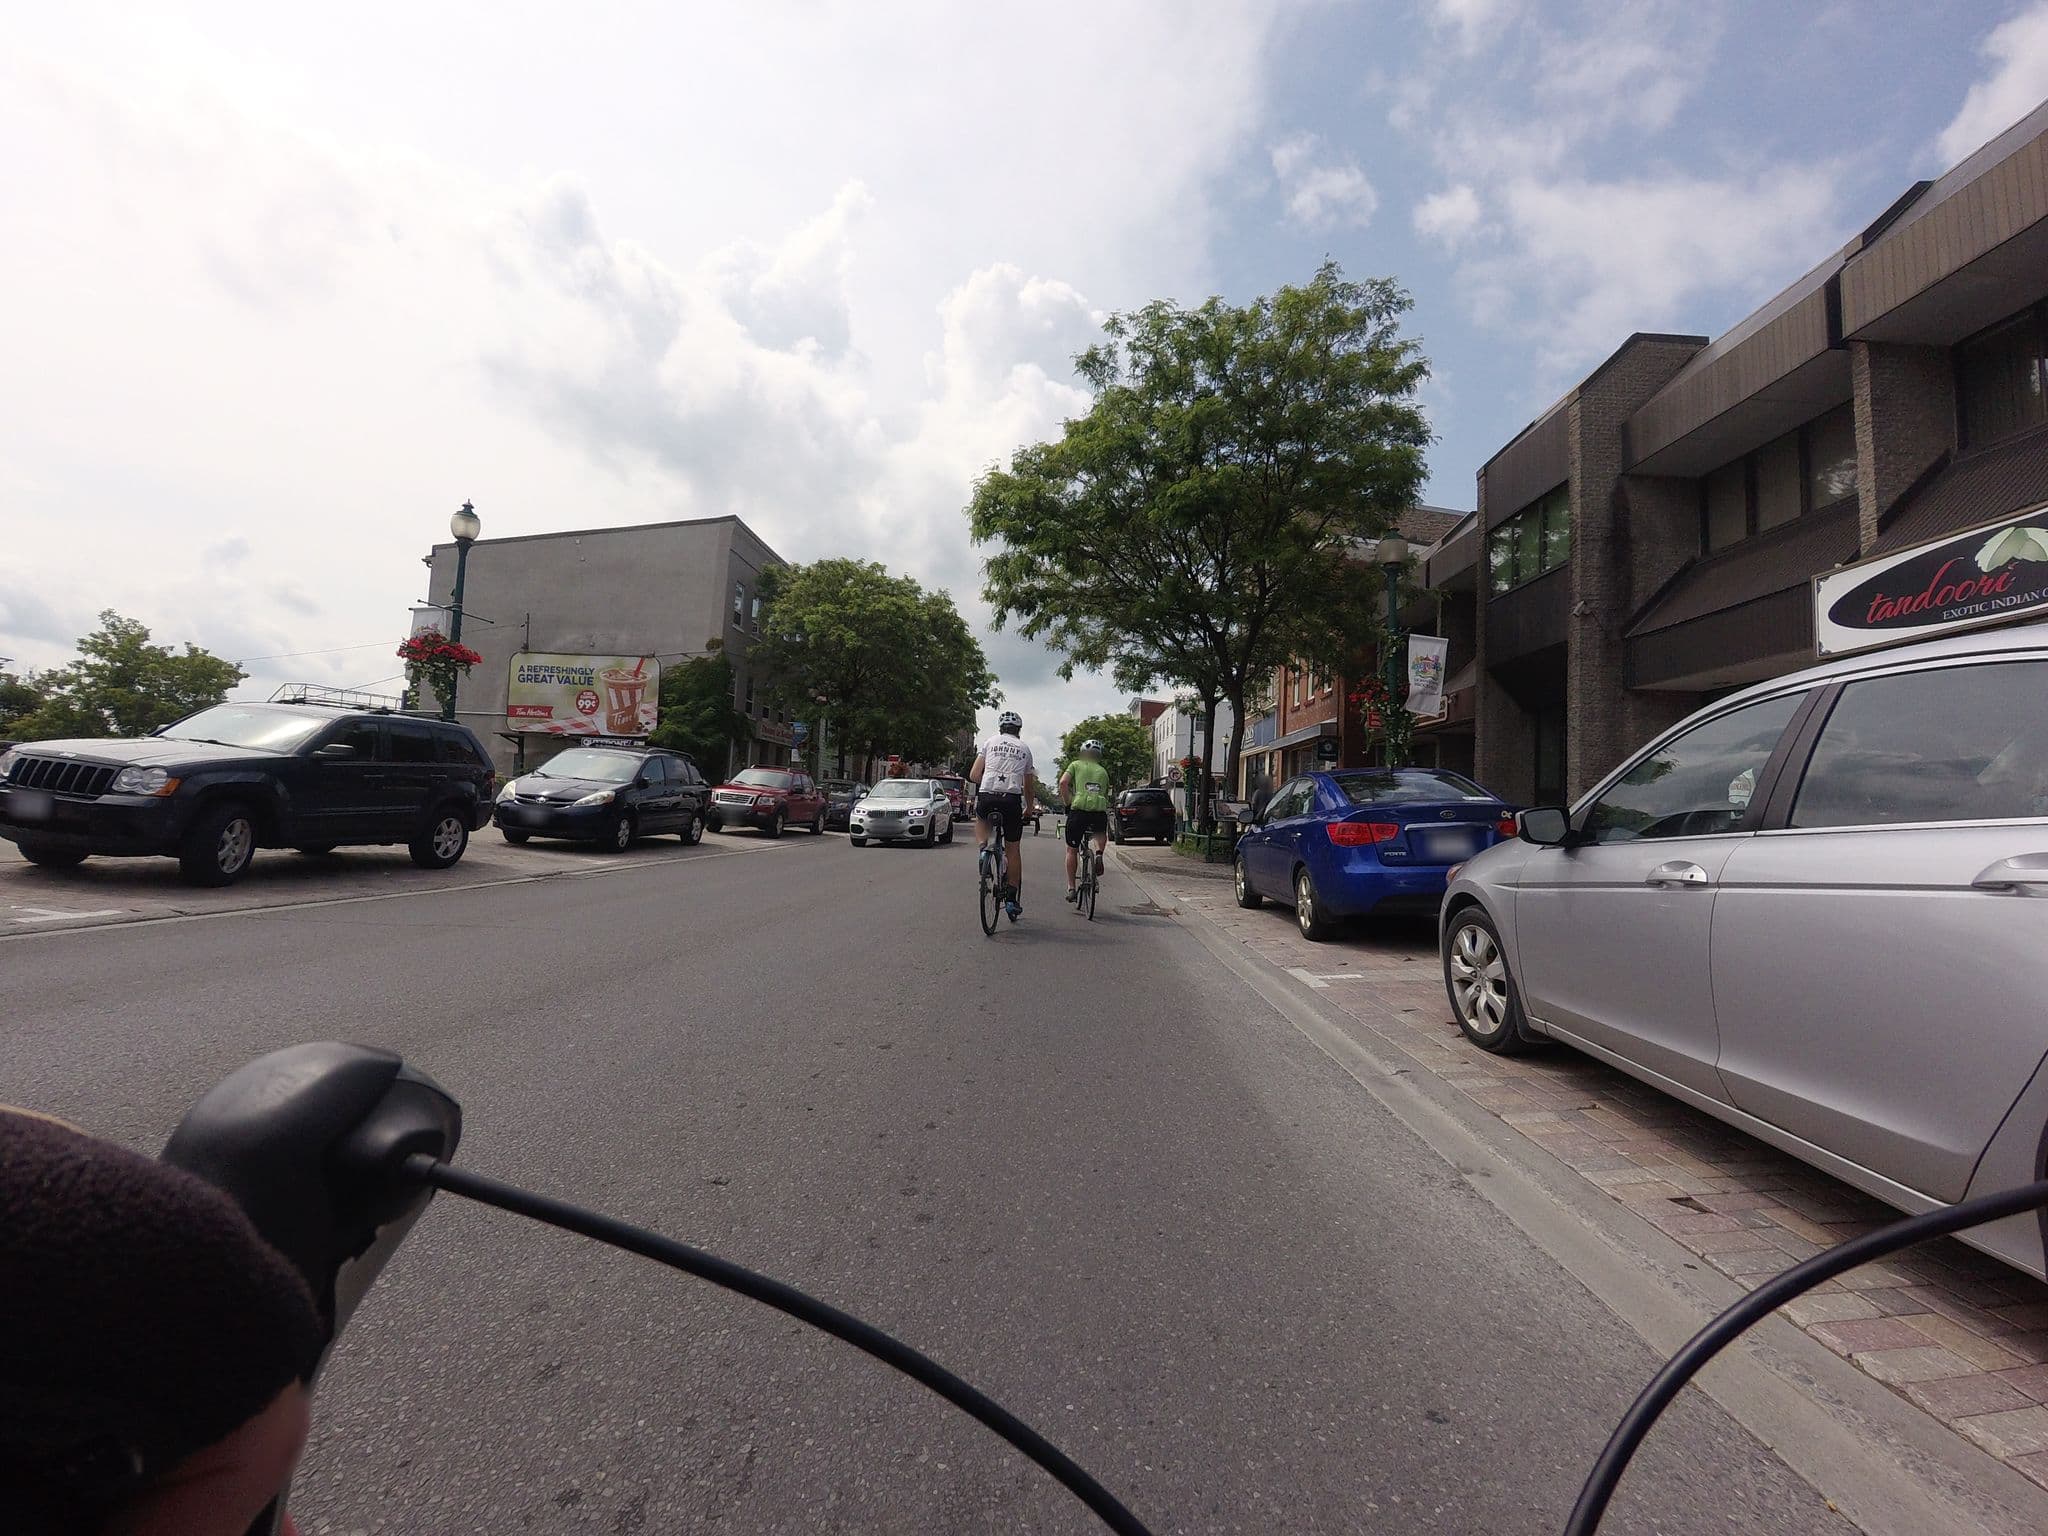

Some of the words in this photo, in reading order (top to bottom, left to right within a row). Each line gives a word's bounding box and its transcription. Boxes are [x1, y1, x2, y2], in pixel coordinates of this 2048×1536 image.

[1866, 556, 2018, 624] tandoori
[1943, 601, 1988, 620] EXOTIC
[1991, 588, 2040, 610] INDIAN
[517, 673, 555, 684] GREAT
[556, 675, 594, 686] VALUE
[518, 665, 525, 673] A
[526, 665, 595, 676] REFRESHINGLY
